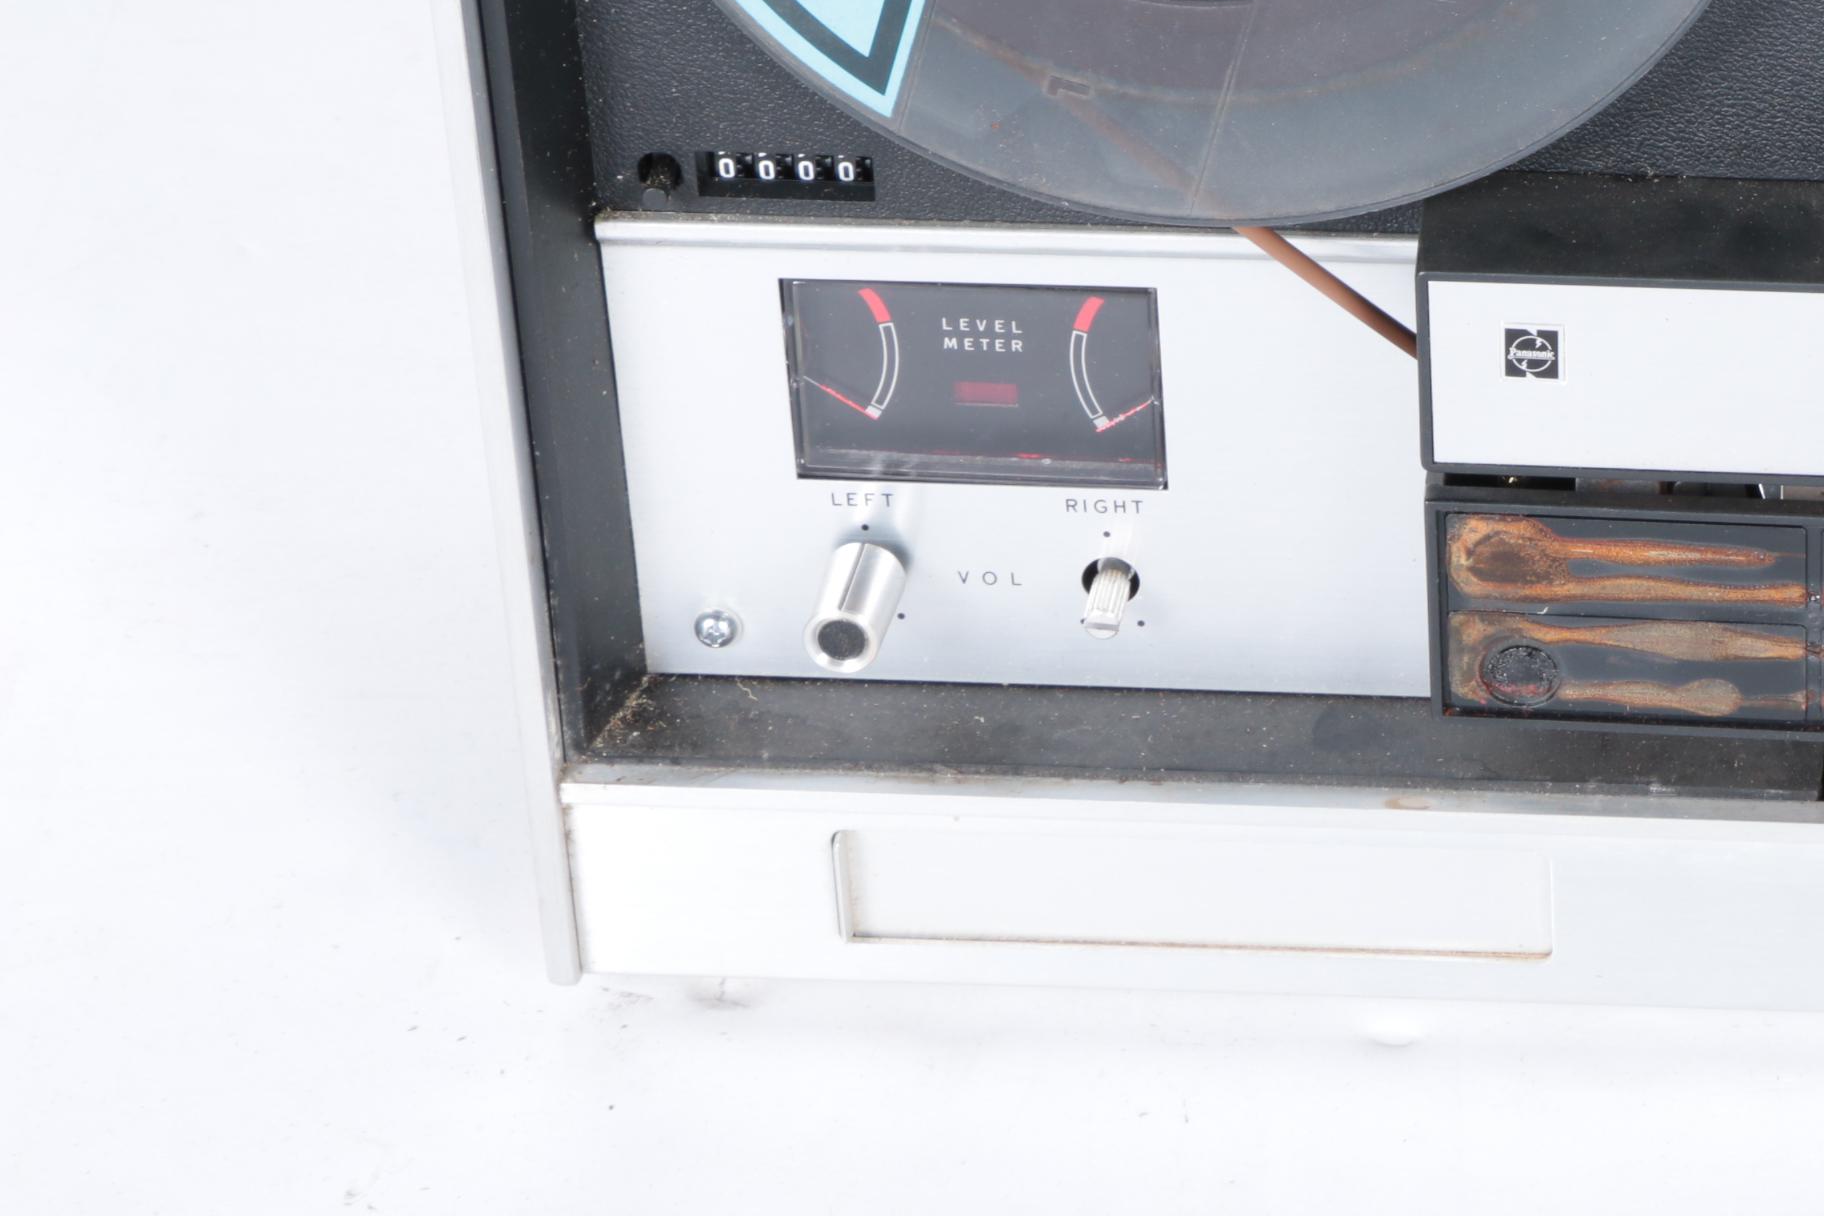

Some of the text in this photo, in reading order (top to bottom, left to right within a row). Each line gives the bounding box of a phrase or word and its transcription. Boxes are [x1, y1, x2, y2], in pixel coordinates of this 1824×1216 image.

[942, 317, 1023, 334] LEVEL
[943, 336, 1023, 352] METER
[1507, 347, 1556, 361] Panasonic
[831, 492, 895, 508] LEFT
[1065, 499, 1145, 515] RIGHT
[957, 570, 1023, 587] VOL
